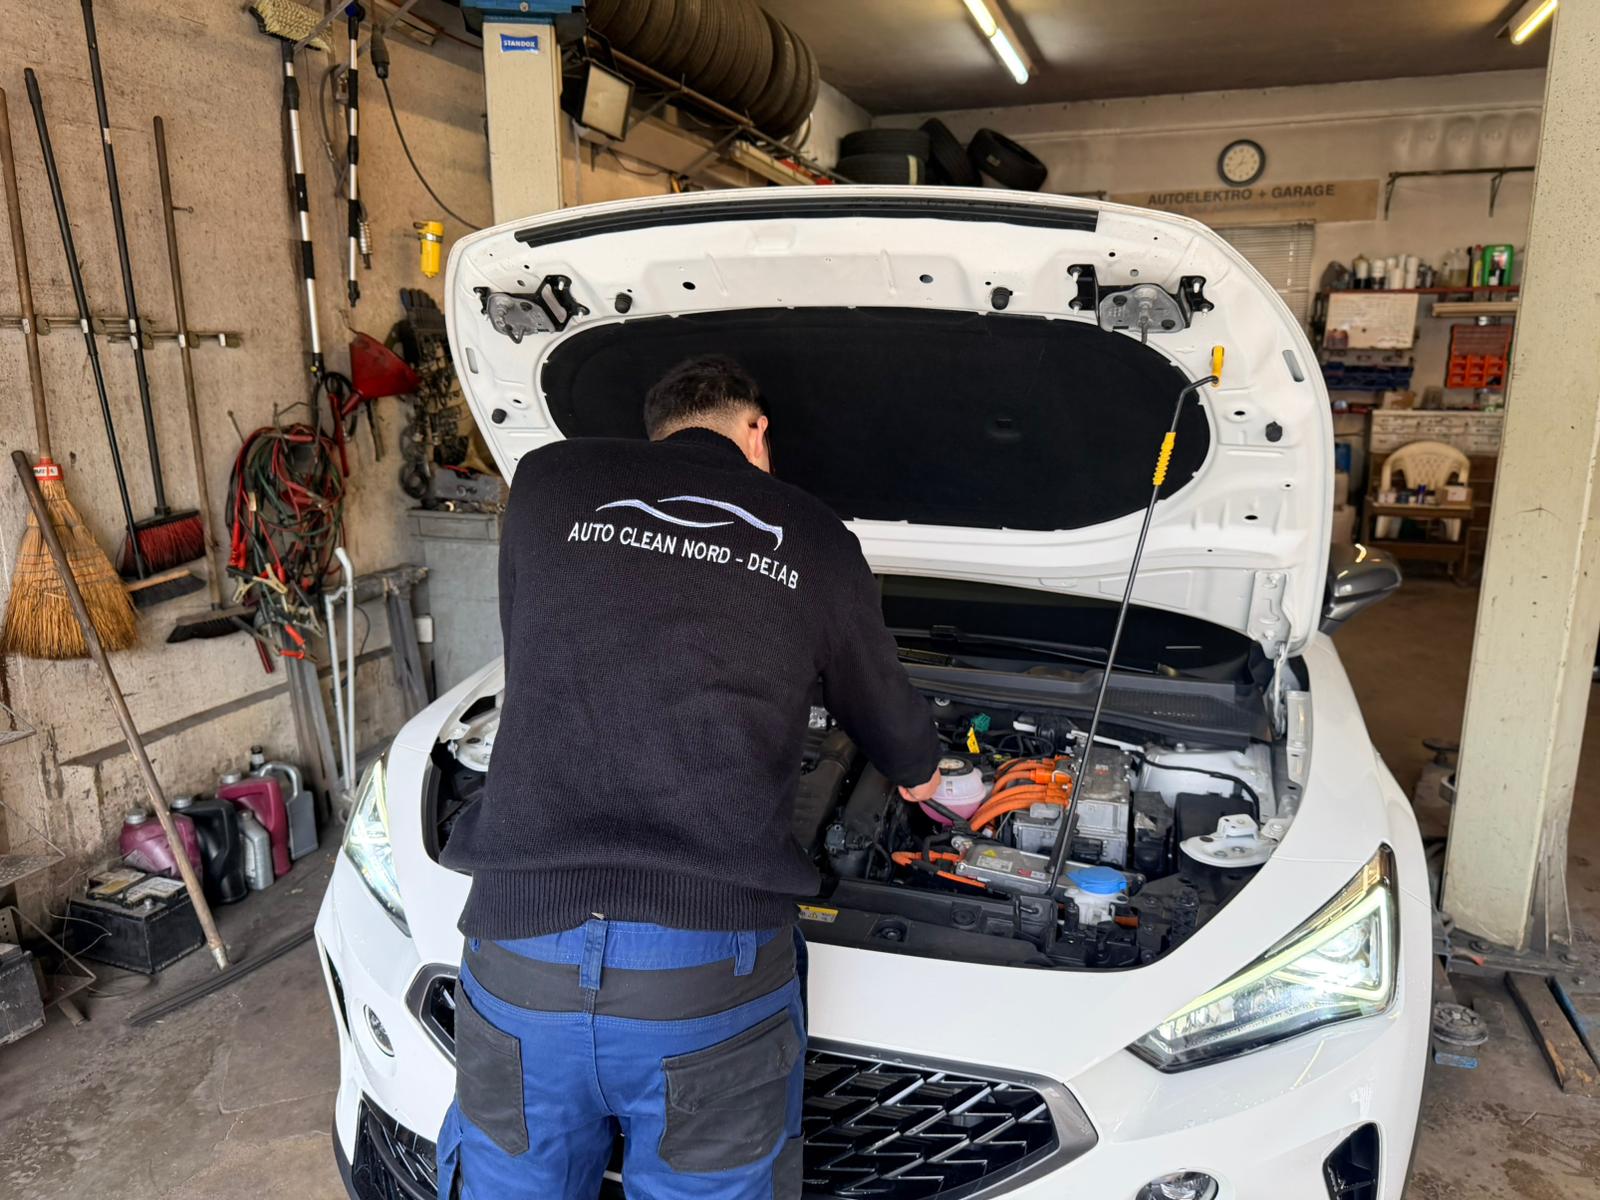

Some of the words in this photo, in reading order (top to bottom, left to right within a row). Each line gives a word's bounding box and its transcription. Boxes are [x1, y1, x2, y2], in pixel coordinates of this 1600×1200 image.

[1148, 189, 1252, 205] AUTOELEKTRO
[1271, 184, 1335, 199] GARAGE
[567, 522, 615, 542] AUTO
[619, 527, 677, 555] CLEAN
[681, 538, 731, 564] NORD
[746, 552, 799, 590] DEIAB
